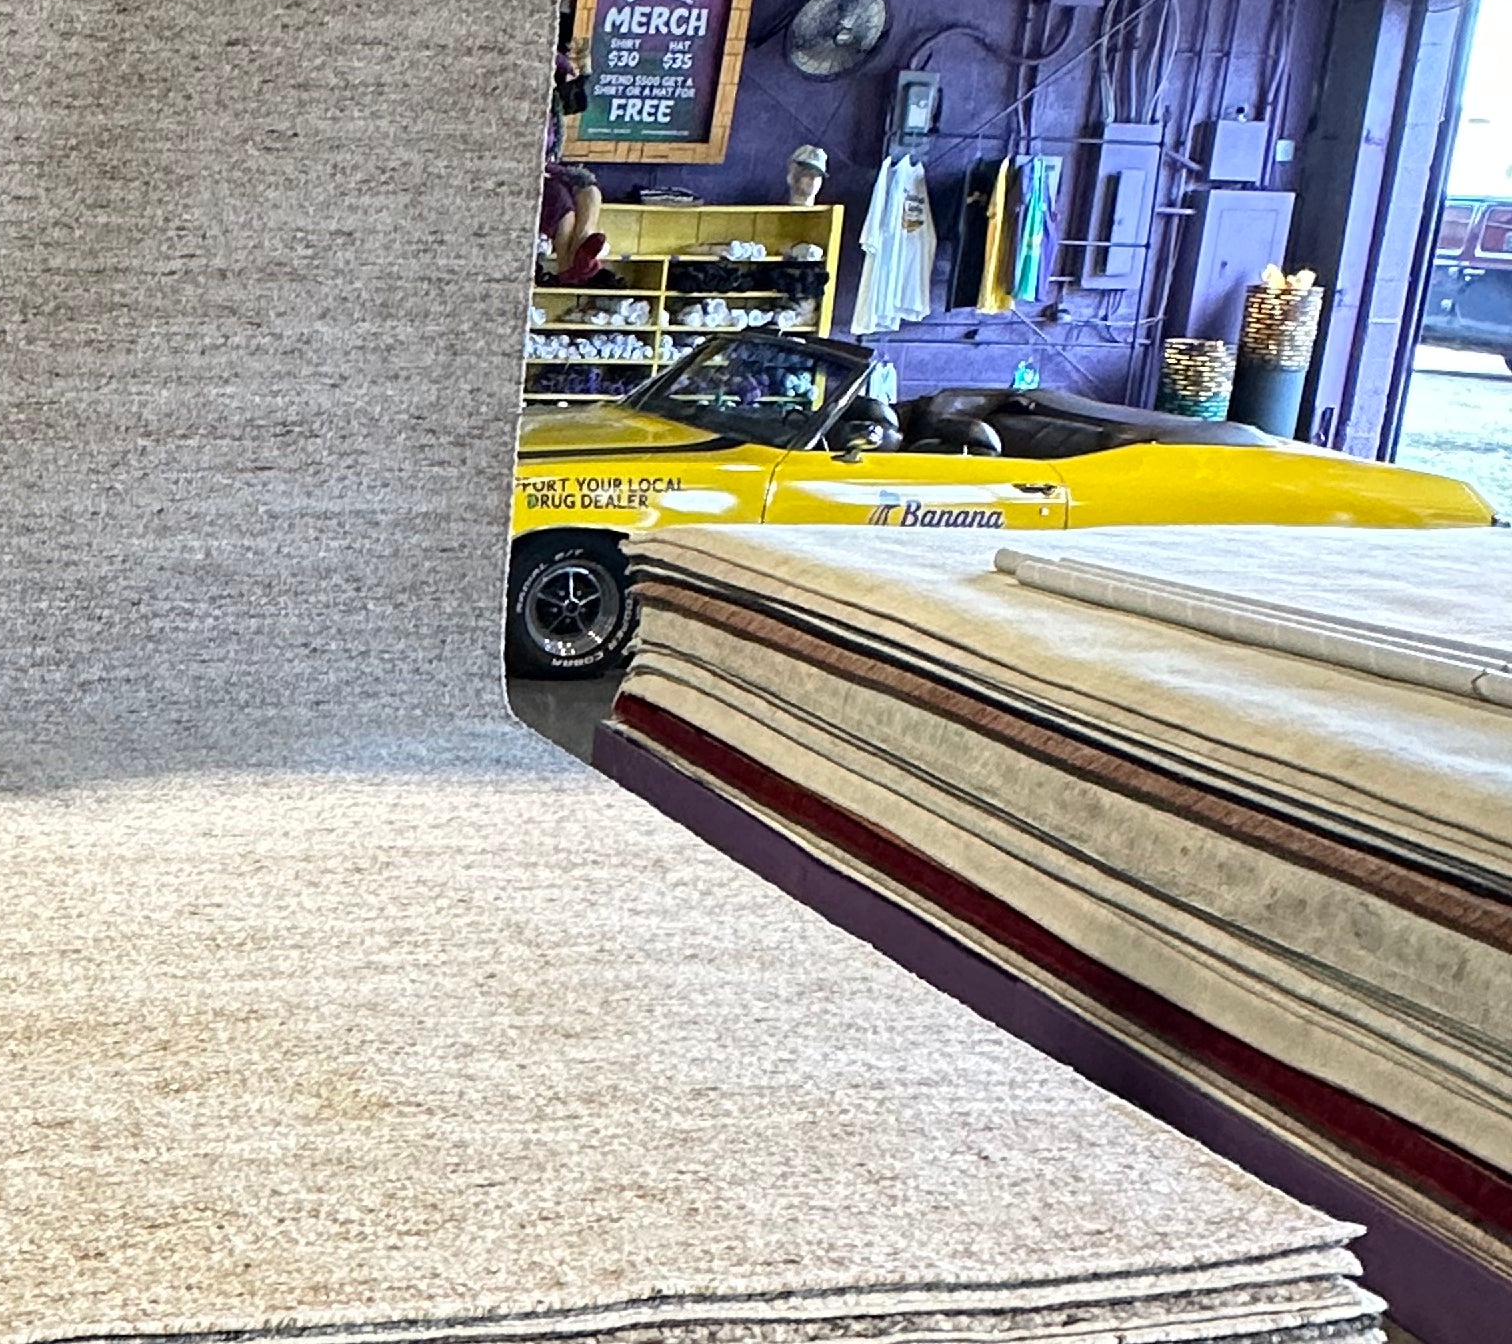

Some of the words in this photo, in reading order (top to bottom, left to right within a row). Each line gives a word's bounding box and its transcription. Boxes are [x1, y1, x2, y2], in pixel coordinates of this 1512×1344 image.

[604, 6, 709, 36] MERCH
[610, 38, 642, 50] SHIRT
[669, 40, 692, 52] HAT
[608, 50, 640, 68] $30
[662, 52, 693, 70] $35
[599, 74, 633, 86] SPEND
[662, 76, 685, 87] GET
[686, 77, 694, 87] A
[593, 84, 624, 97] SHIRT
[626, 85, 642, 97] OR
[642, 86, 651, 97] A
[652, 86, 675, 98] HAT
[674, 87, 696, 99] FOR
[609, 98, 676, 123] FREE
[575, 478, 623, 493] YOUR
[628, 477, 683, 493] LOCAL
[527, 493, 576, 510] DRUG
[580, 494, 650, 510] DEALER
[900, 499, 1006, 530] Banana
